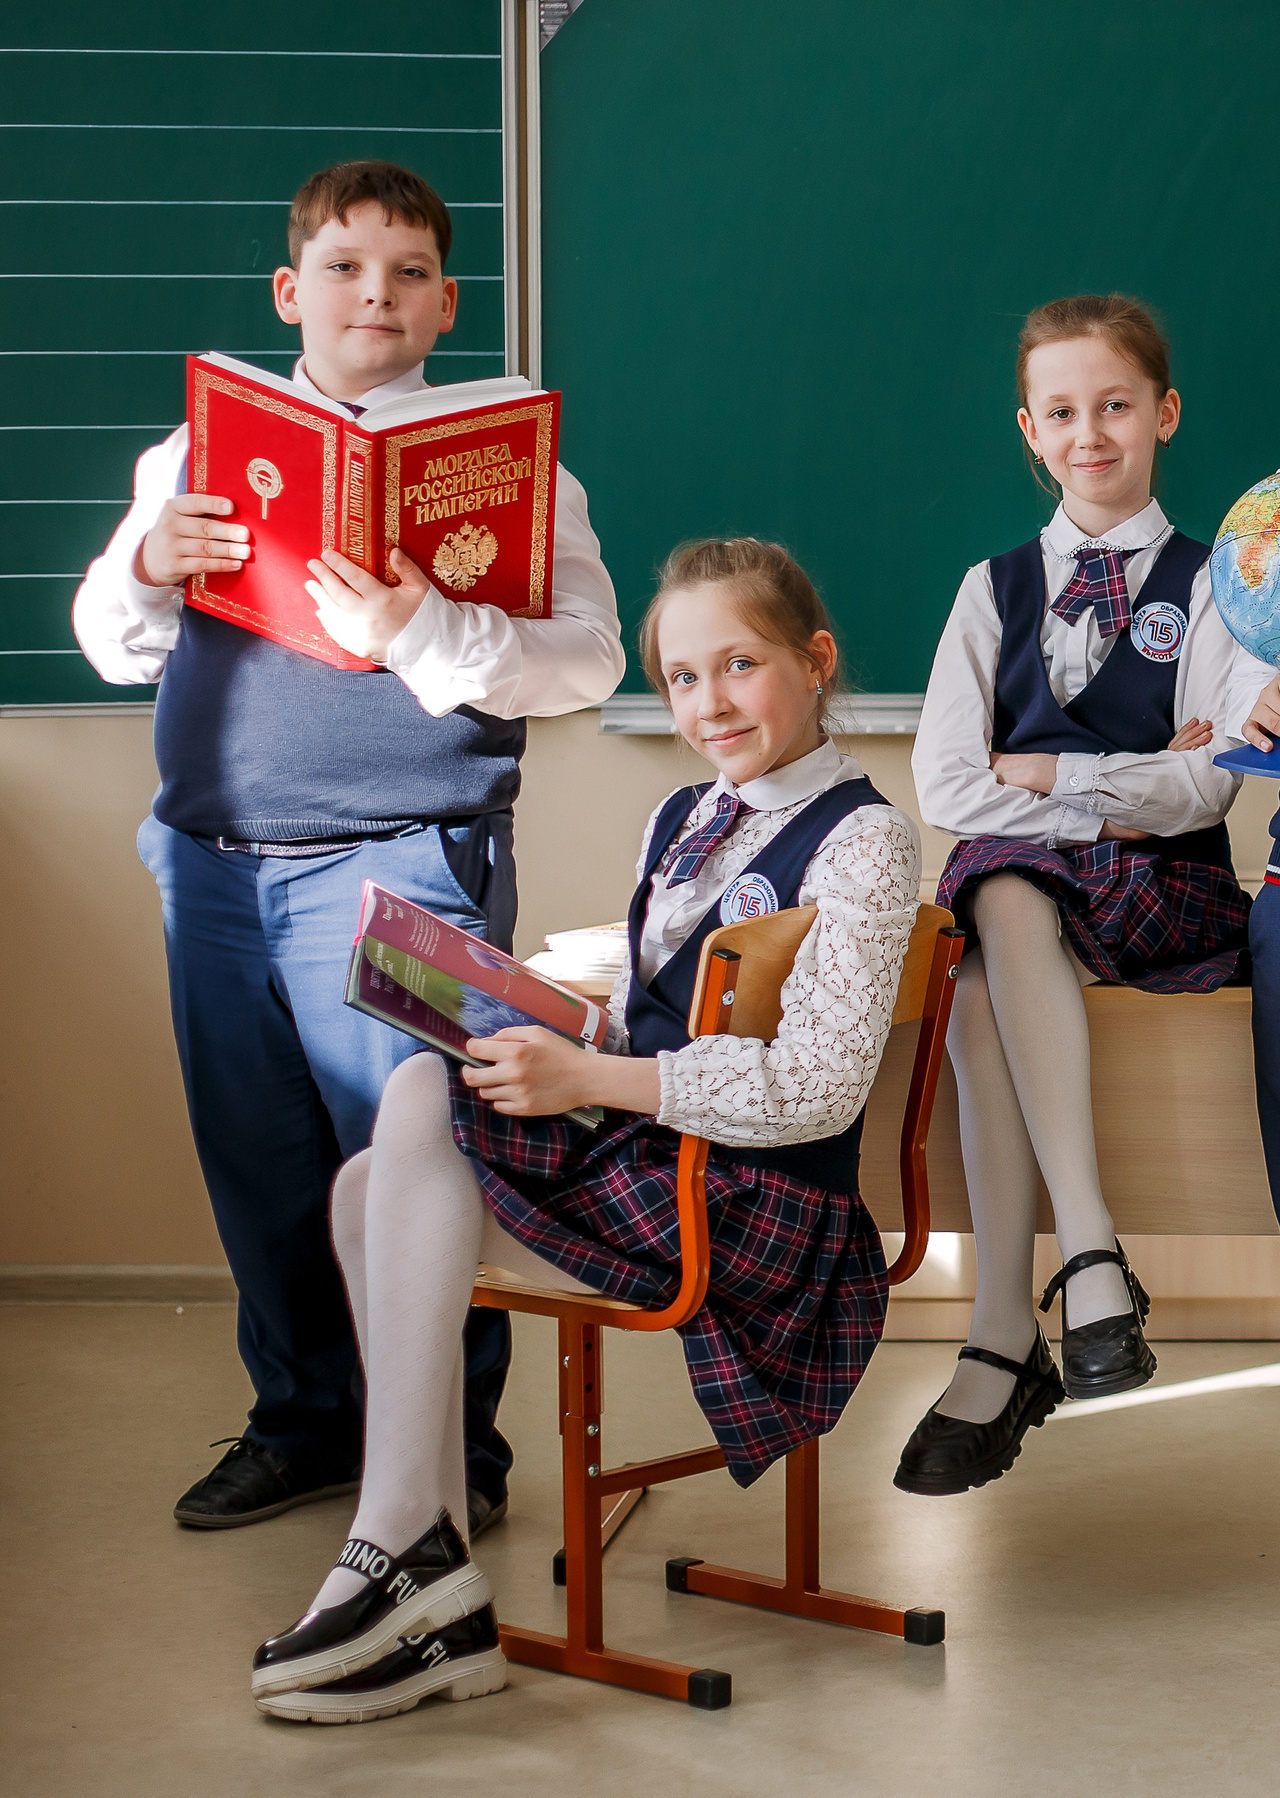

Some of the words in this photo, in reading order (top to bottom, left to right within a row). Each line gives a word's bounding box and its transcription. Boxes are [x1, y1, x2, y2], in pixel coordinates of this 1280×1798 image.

[423, 443, 513, 480] МОРДВА
[349, 459, 364, 519] ИМПЕРИИ
[403, 455, 533, 507] РОССИЙСКОЙ
[414, 482, 519, 526] ИМПЕРИИ
[1148, 620, 1174, 644] 15
[1141, 646, 1174, 660] ВЫСОТА
[723, 881, 740, 904] ЦЕНТР
[737, 892, 762, 919] 15
[752, 876, 776, 914] ОБРАЗОВАНИ
[387, 1571, 422, 1605] FU
